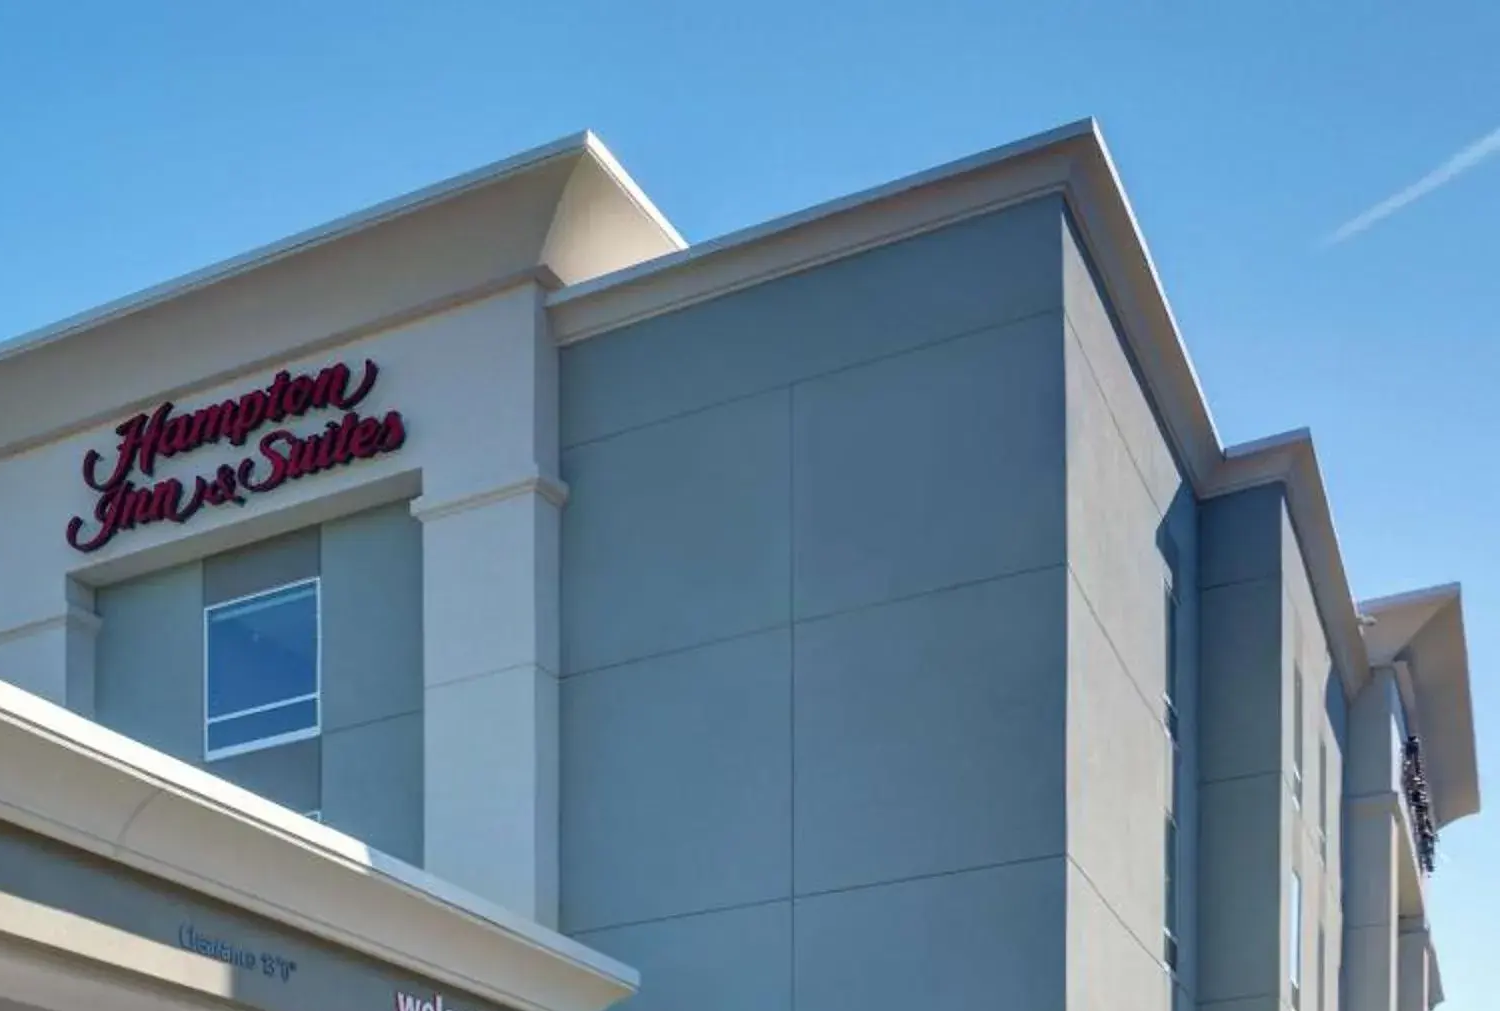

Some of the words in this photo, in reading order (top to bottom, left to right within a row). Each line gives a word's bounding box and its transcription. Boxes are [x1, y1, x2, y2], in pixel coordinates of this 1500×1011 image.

[66, 474, 204, 553] Inn
[200, 463, 248, 507] &
[238, 410, 406, 493] Suites
[82, 358, 380, 492] Hampton
